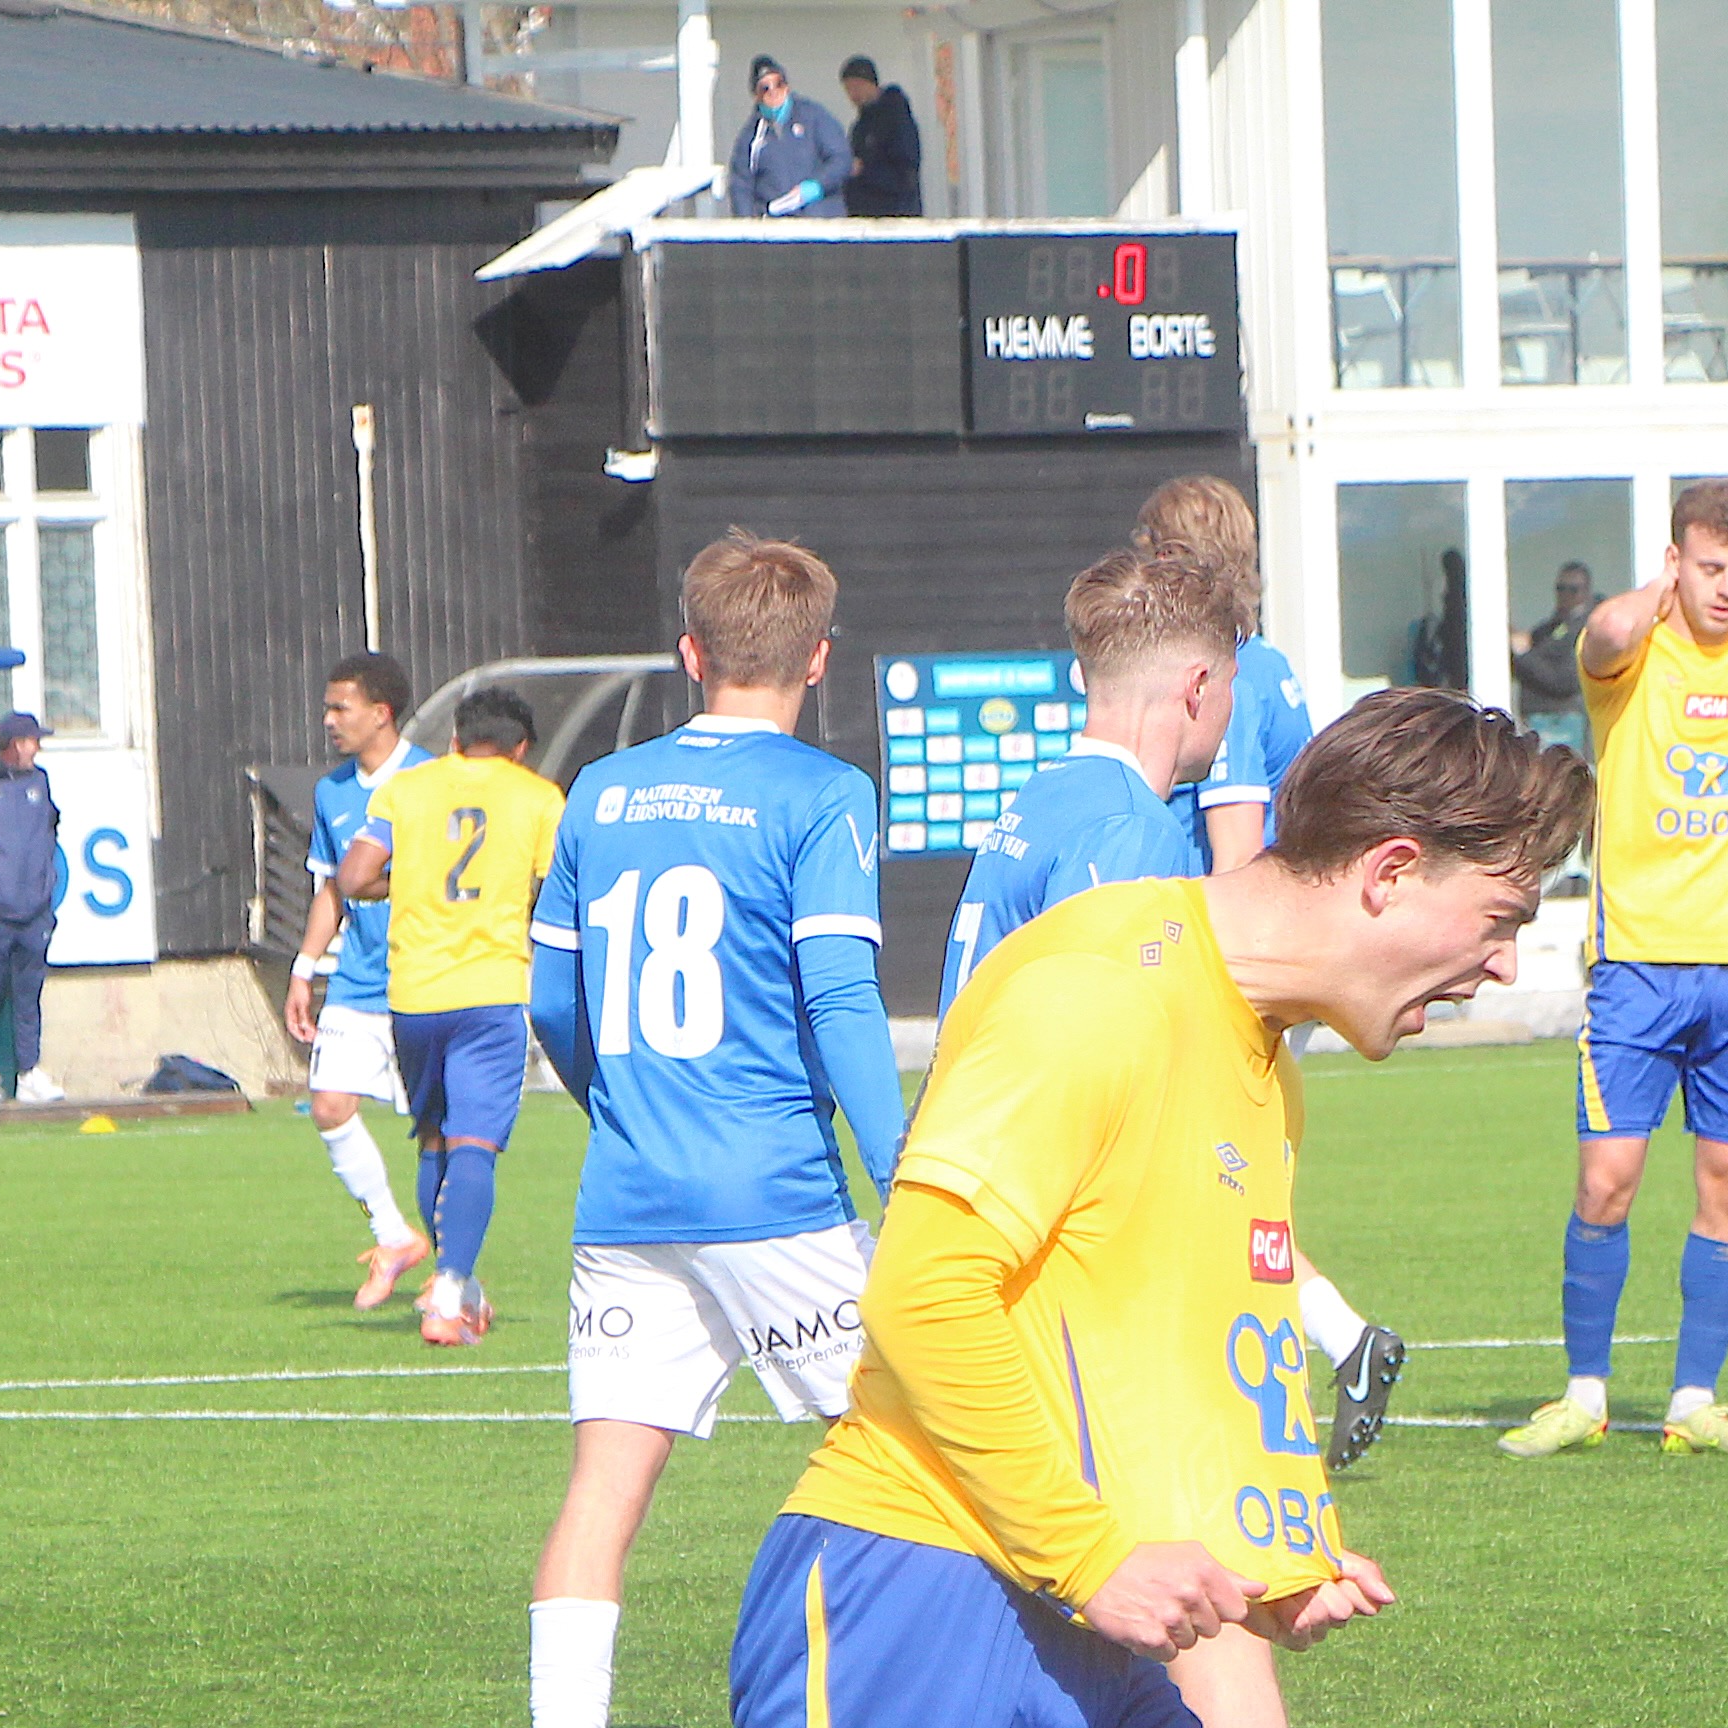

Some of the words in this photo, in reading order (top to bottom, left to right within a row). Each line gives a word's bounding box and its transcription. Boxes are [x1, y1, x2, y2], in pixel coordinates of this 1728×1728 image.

[985, 315, 1094, 360] HJEMME
[1129, 314, 1216, 359] BORTE
[1685, 697, 1728, 717] PGM
[623, 801, 702, 824] EIDSVOLD
[705, 804, 758, 828] VÆRK
[629, 783, 723, 805] MATHIESEN
[446, 806, 487, 902] 2
[586, 863, 725, 1060] 18
[750, 1298, 862, 1356] JAMO
